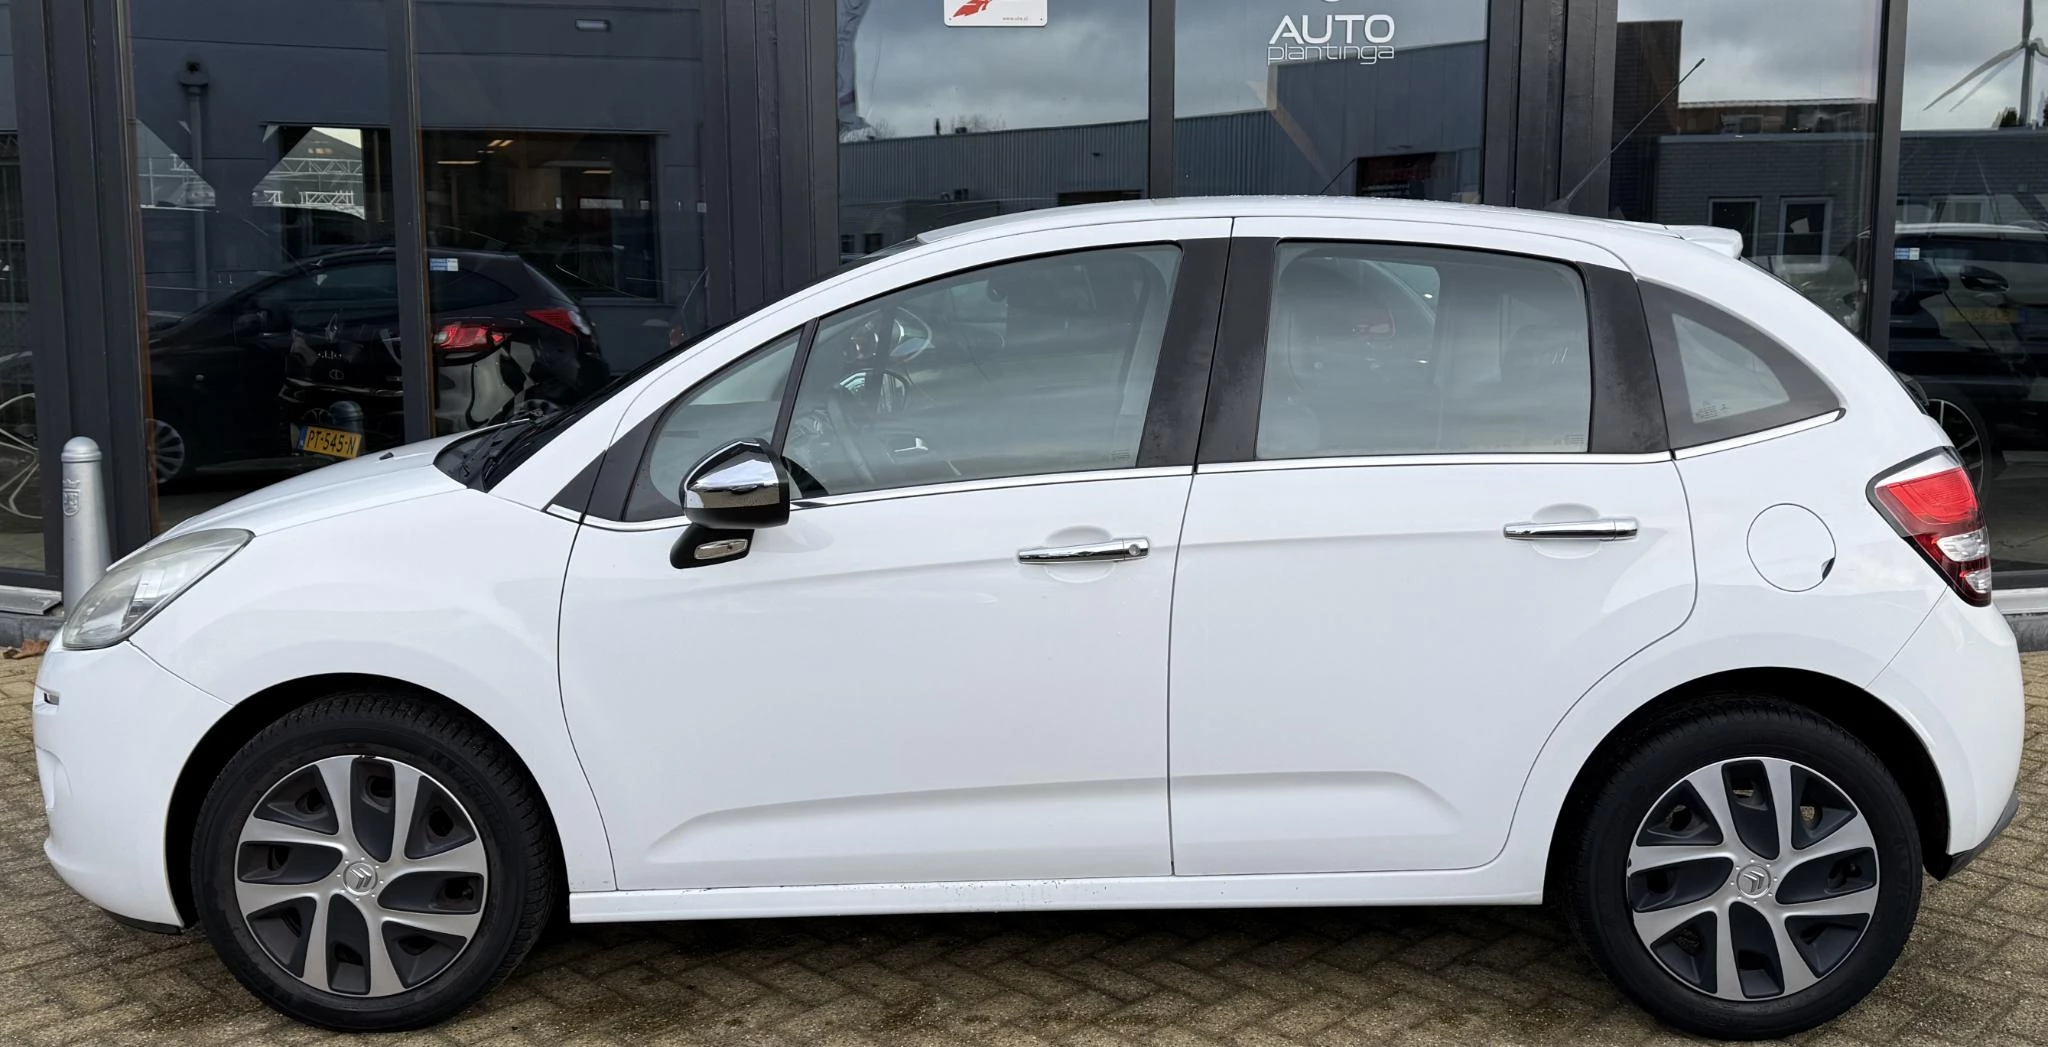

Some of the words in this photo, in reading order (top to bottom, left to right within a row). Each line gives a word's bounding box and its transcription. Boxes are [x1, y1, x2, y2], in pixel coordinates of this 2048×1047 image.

[1269, 14, 1395, 44] AUTO
[1267, 42, 1395, 65] plantinga
[306, 429, 358, 455] PT-545-N
